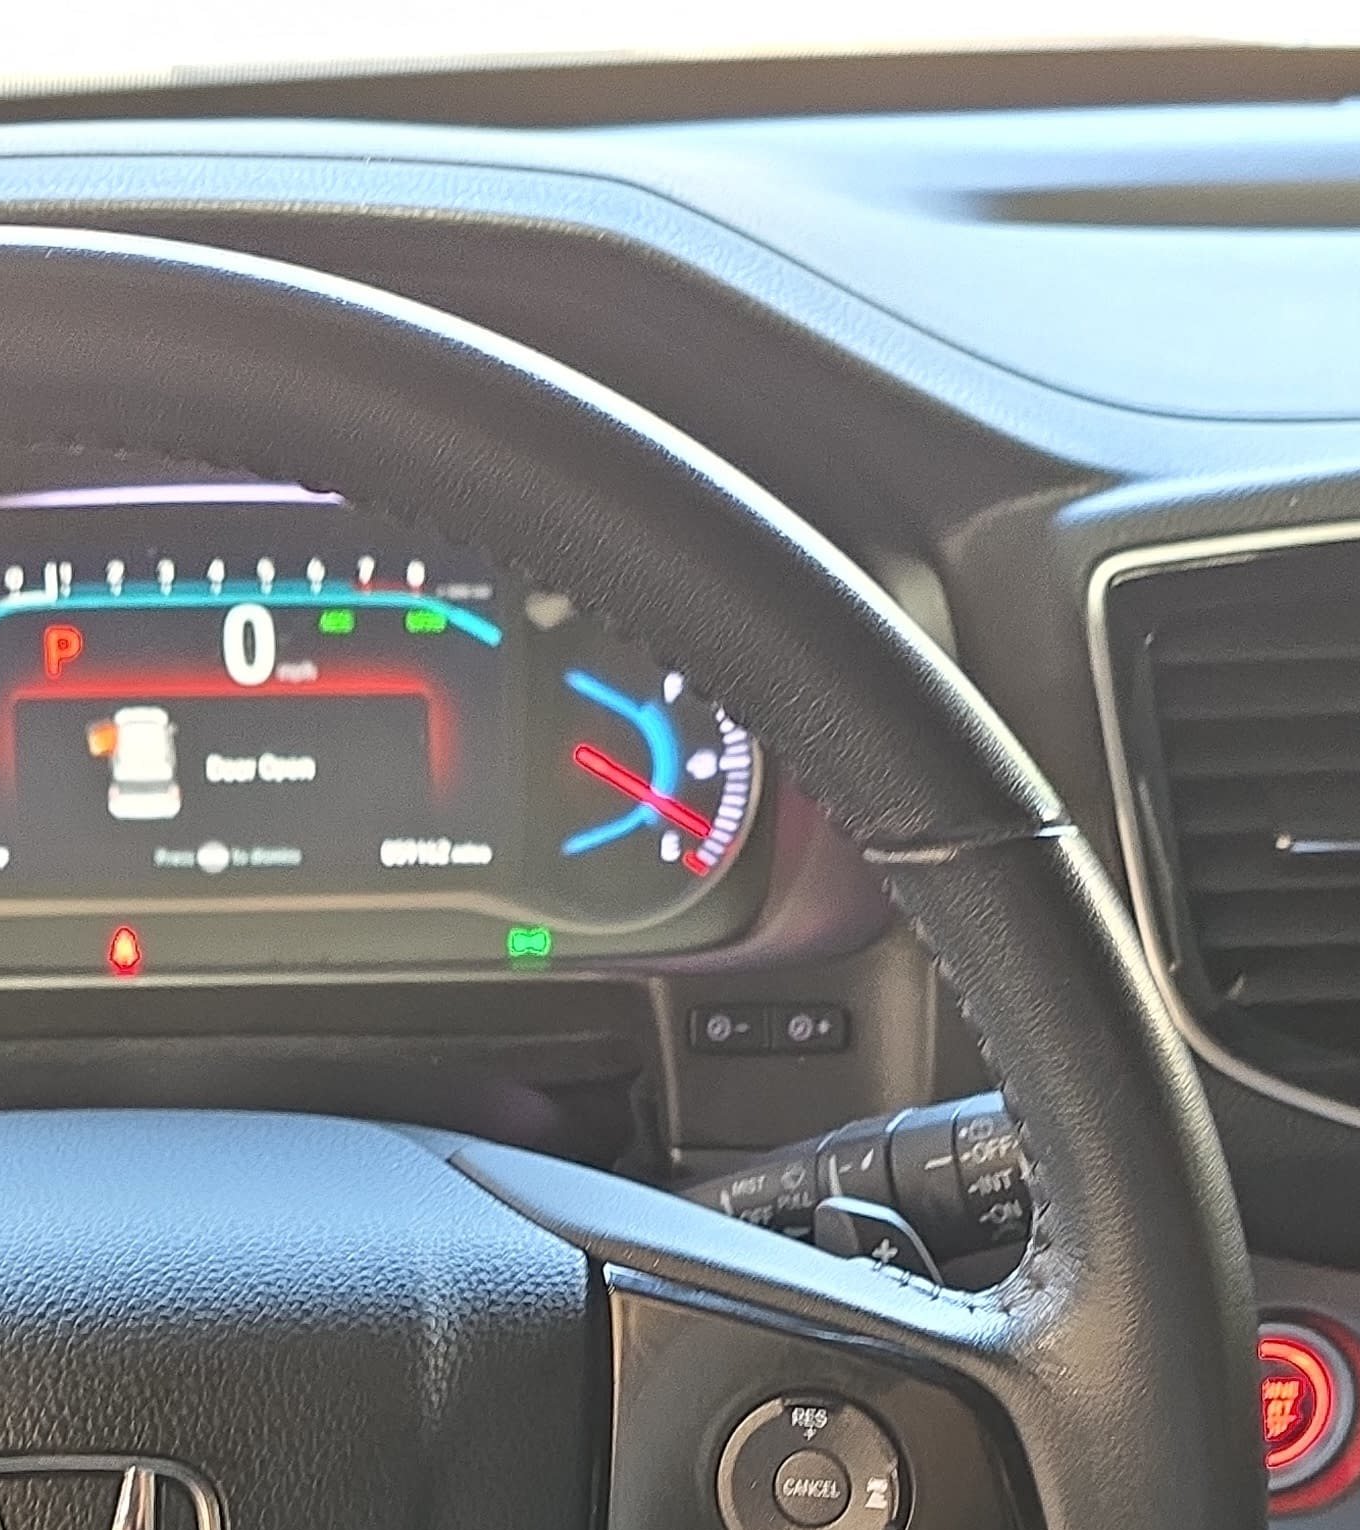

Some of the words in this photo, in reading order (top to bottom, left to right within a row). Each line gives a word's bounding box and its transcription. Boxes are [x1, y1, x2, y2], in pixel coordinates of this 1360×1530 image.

[44, 625, 83, 678] P
[223, 603, 276, 685] 0
[791, 1407, 828, 1429] RES
[782, 1477, 841, 1500] CANCEL
